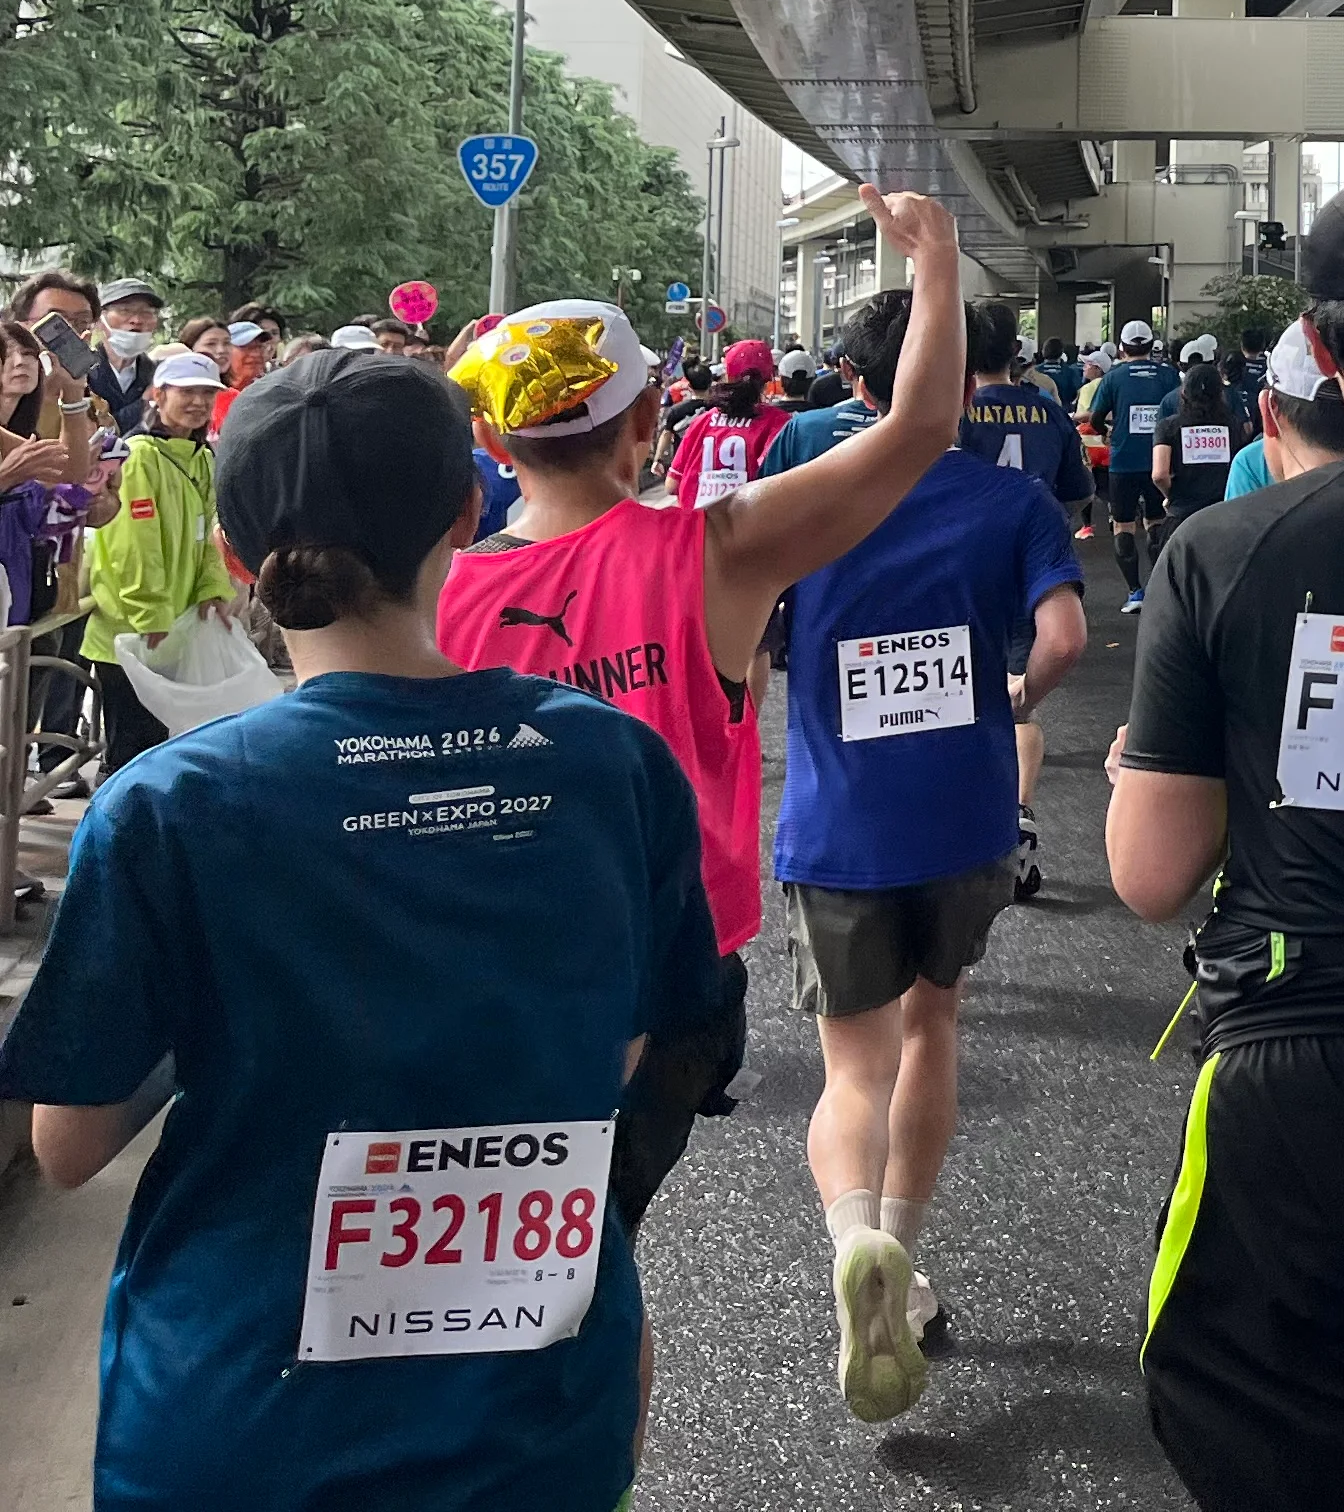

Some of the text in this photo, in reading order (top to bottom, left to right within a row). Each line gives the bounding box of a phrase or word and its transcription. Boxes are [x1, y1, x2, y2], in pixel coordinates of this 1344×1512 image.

[471, 153, 525, 181] 357
[701, 434, 747, 472] 19
[1184, 436, 1227, 449] J33801
[877, 632, 950, 656] ENEOS
[847, 655, 969, 700] E12514
[879, 709, 924, 729] PUMA
[334, 726, 501, 754] YOKOHAMA 2026
[337, 749, 436, 766] MARATHON
[342, 809, 418, 833] GREEN
[500, 795, 553, 815] 2027
[408, 819, 499, 837] YOKOHAMA JAPAN
[406, 1132, 570, 1174] ENEOS
[324, 1187, 597, 1271] F32188
[348, 1305, 546, 1339] NISSAN
